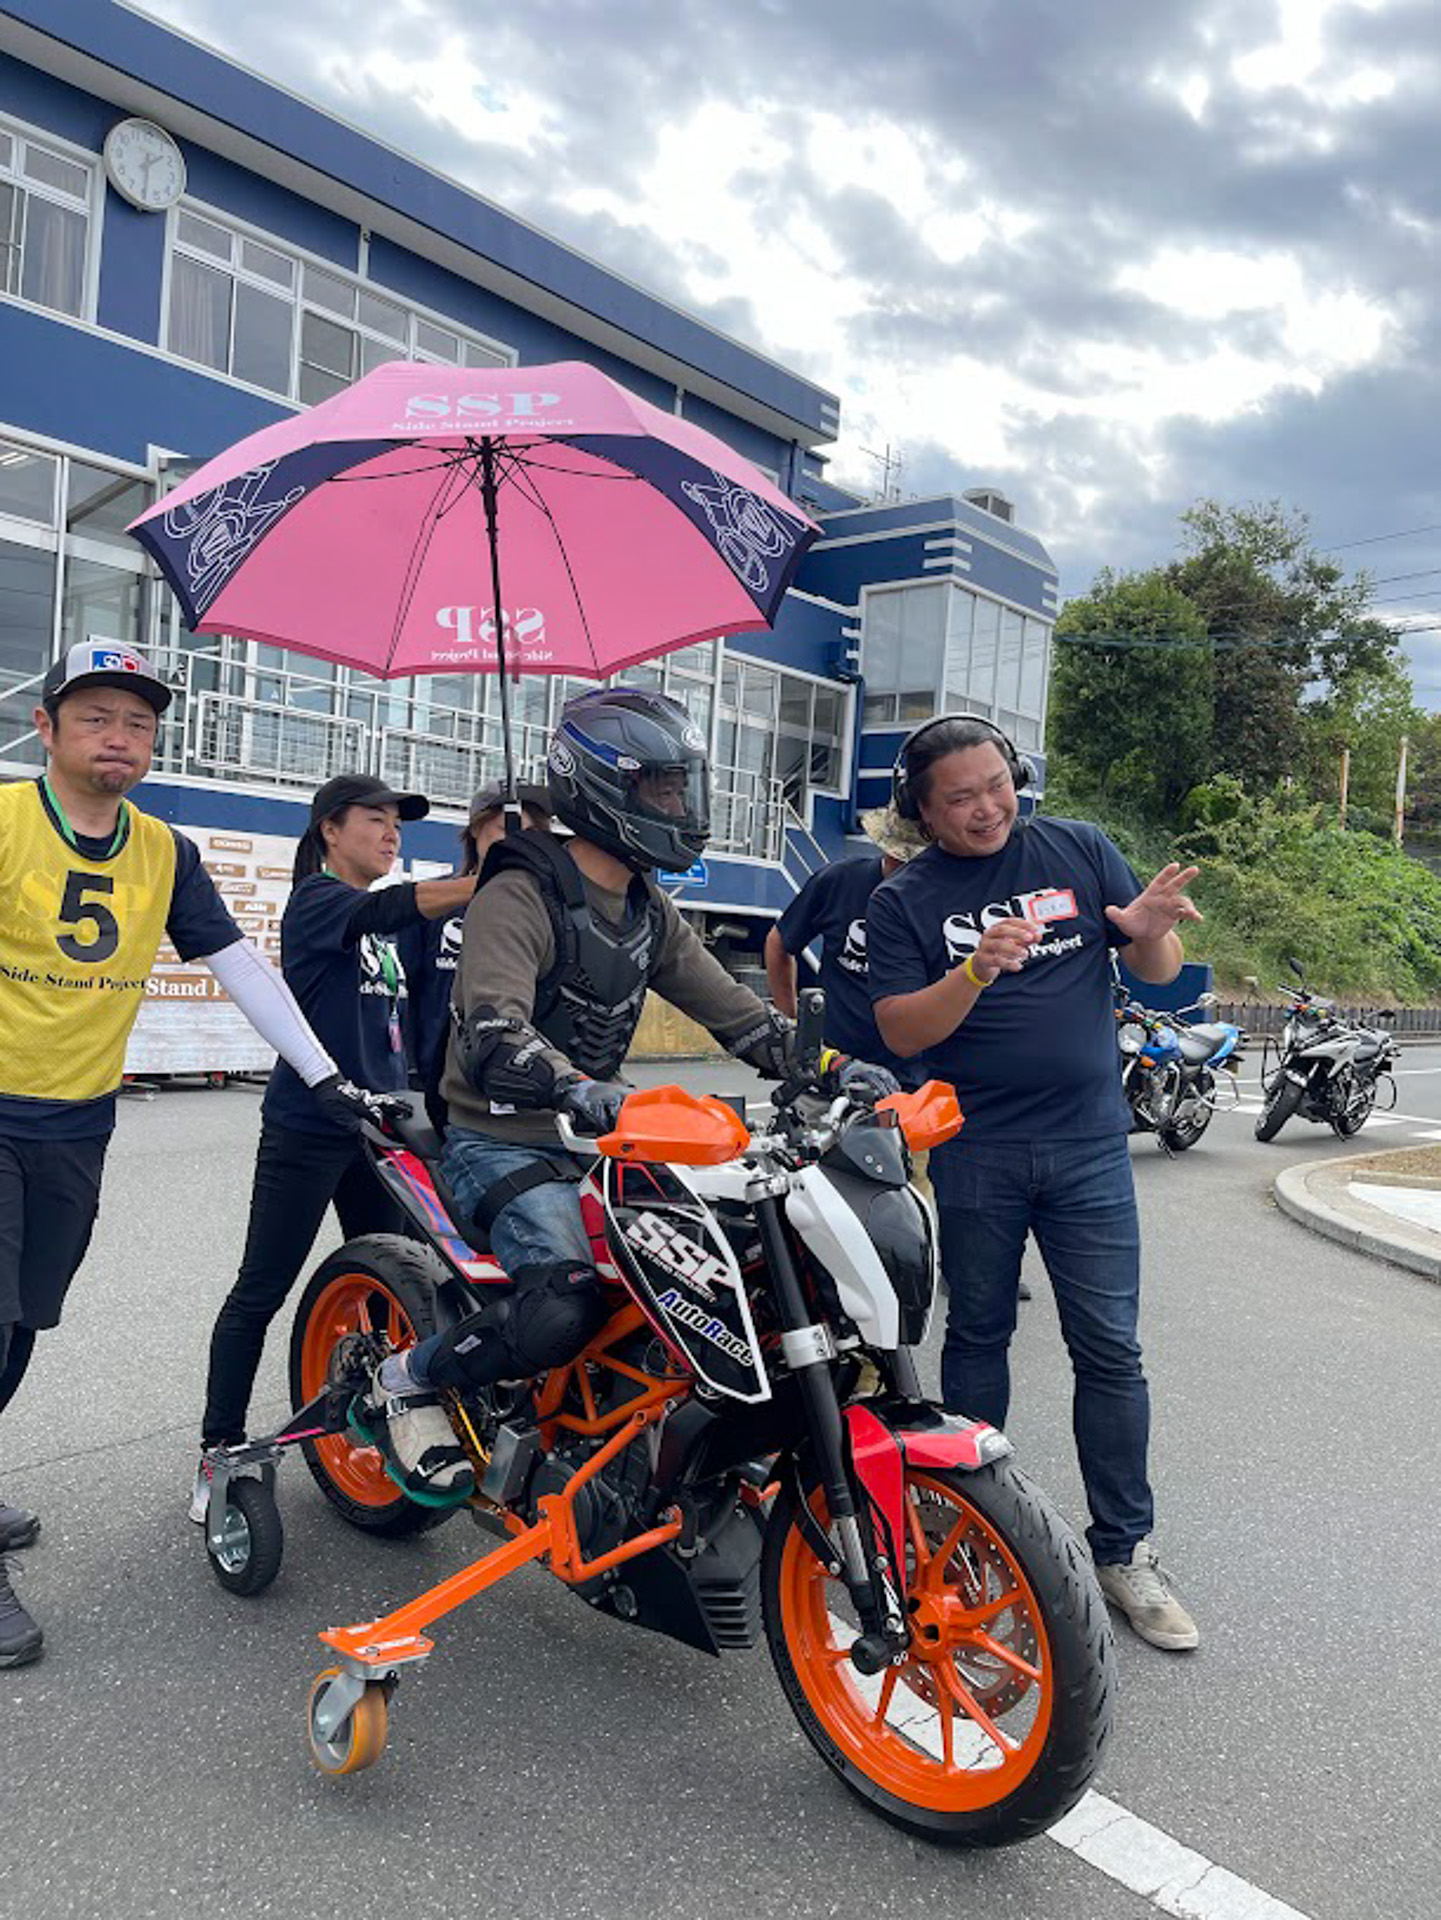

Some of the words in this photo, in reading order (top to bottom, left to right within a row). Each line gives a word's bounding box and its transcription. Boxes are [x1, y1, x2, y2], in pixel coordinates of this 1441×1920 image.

[405, 392, 562, 418] SSP
[56, 869, 119, 963] 5
[1028, 933, 1084, 957] Project
[0, 966, 38, 983] Side
[43, 971, 95, 990] Stand
[145, 977, 207, 996] Stand
[627, 1211, 737, 1290] SSP
[656, 1287, 755, 1368] AutoRace
